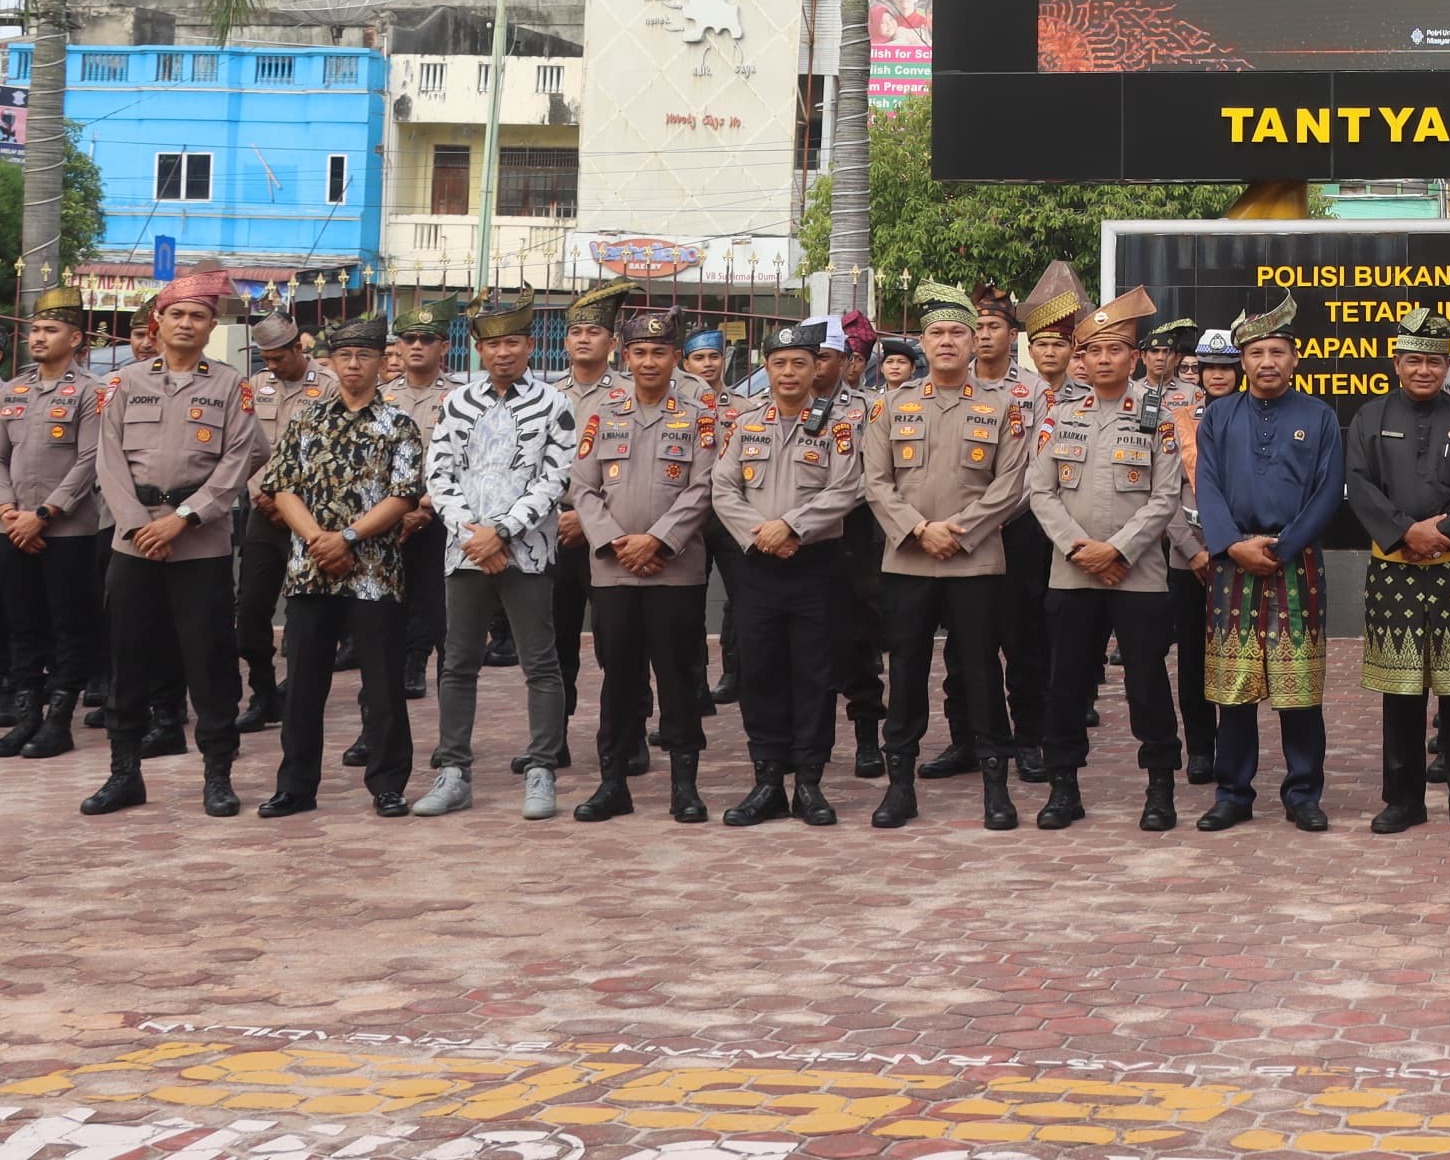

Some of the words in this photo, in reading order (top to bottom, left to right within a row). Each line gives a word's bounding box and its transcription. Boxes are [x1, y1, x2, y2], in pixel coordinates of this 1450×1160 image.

[870, 48, 892, 59] lish
[895, 48, 912, 59] for
[915, 48, 933, 59] Sc
[869, 65, 891, 75] lish
[1220, 106, 1450, 145] TANTYA
[1257, 265, 1346, 288] POLISI
[1294, 337, 1379, 359] RAPAN
[50, 396, 76, 405] POLRI
[129, 396, 161, 405] JODHY
[191, 396, 224, 408] POLRI
[1018, 401, 1032, 409] LRI
[894, 415, 924, 423] RIZA
[966, 415, 998, 426] POLRI
[661, 432, 692, 441] POLRI
[1116, 435, 1148, 446] POLRI
[797, 437, 831, 450] POLRI
